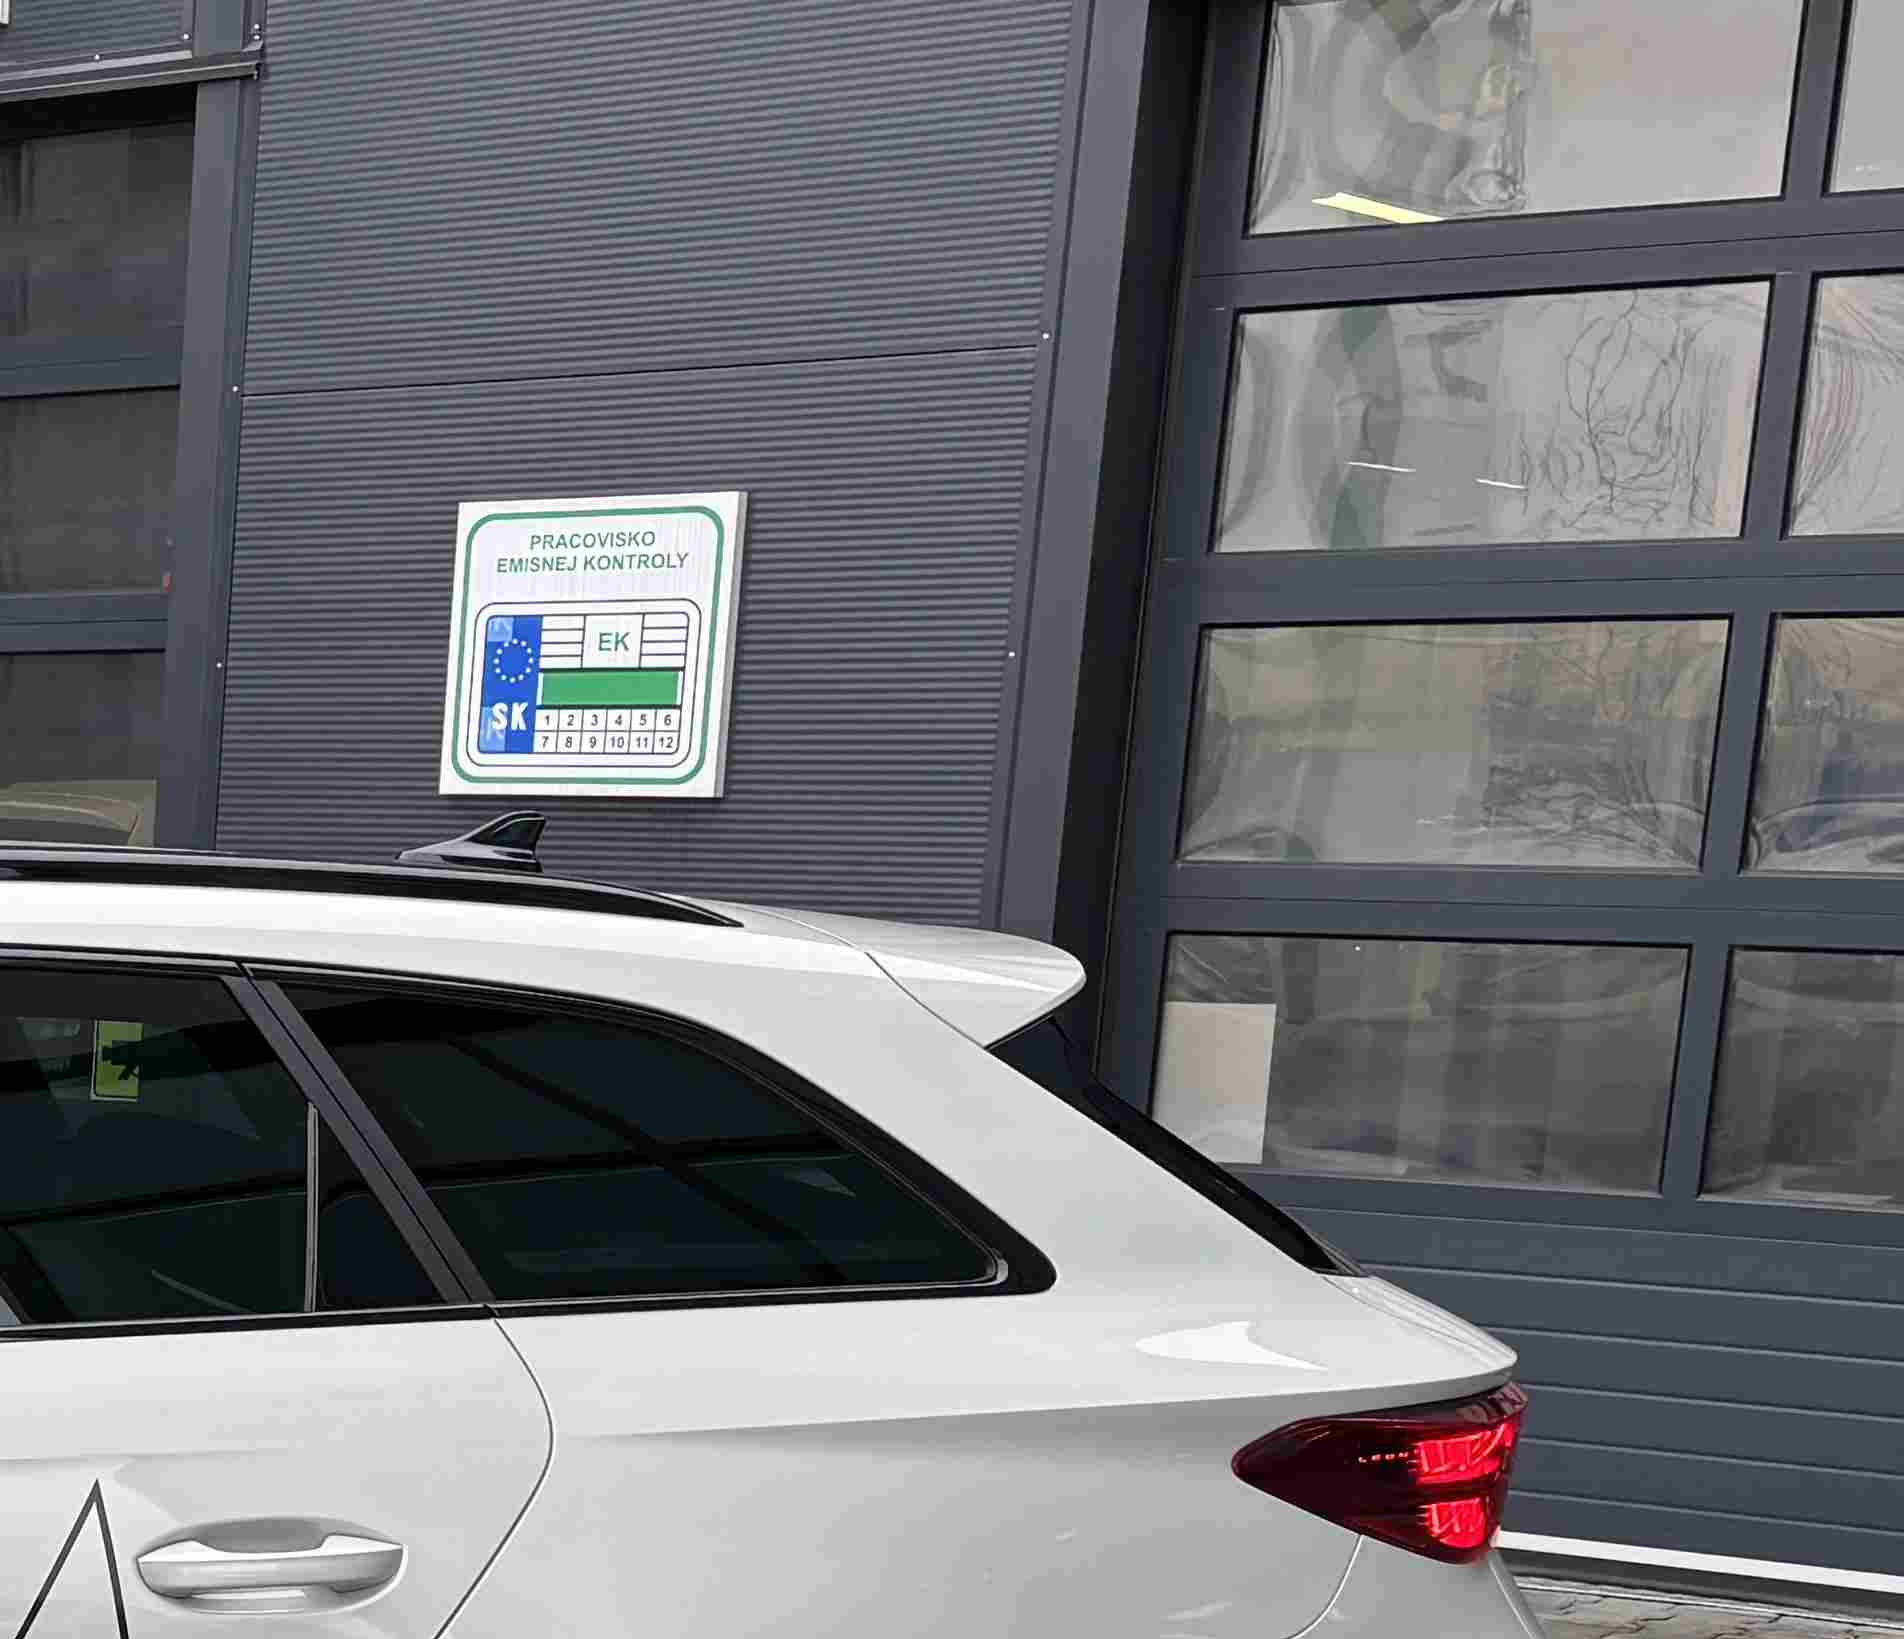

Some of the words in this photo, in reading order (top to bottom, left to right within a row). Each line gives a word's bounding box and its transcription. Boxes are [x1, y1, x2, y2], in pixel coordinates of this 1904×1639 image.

[529, 530, 656, 550] PRACOVISKO
[496, 555, 577, 573] EMISNEJ
[583, 552, 688, 571] KONTROLY
[598, 631, 631, 652] EK
[492, 702, 528, 731] SK
[544, 713, 550, 727] 1
[567, 713, 575, 727] 2
[590, 713, 599, 727] 3
[613, 713, 623, 727] 4
[639, 713, 647, 727] 5
[663, 713, 672, 727] 6
[542, 736, 549, 749] 7
[564, 736, 573, 749] 8
[588, 736, 597, 749] 9
[610, 736, 624, 749] 10
[636, 736, 649, 749] 11
[659, 736, 673, 749] 12
